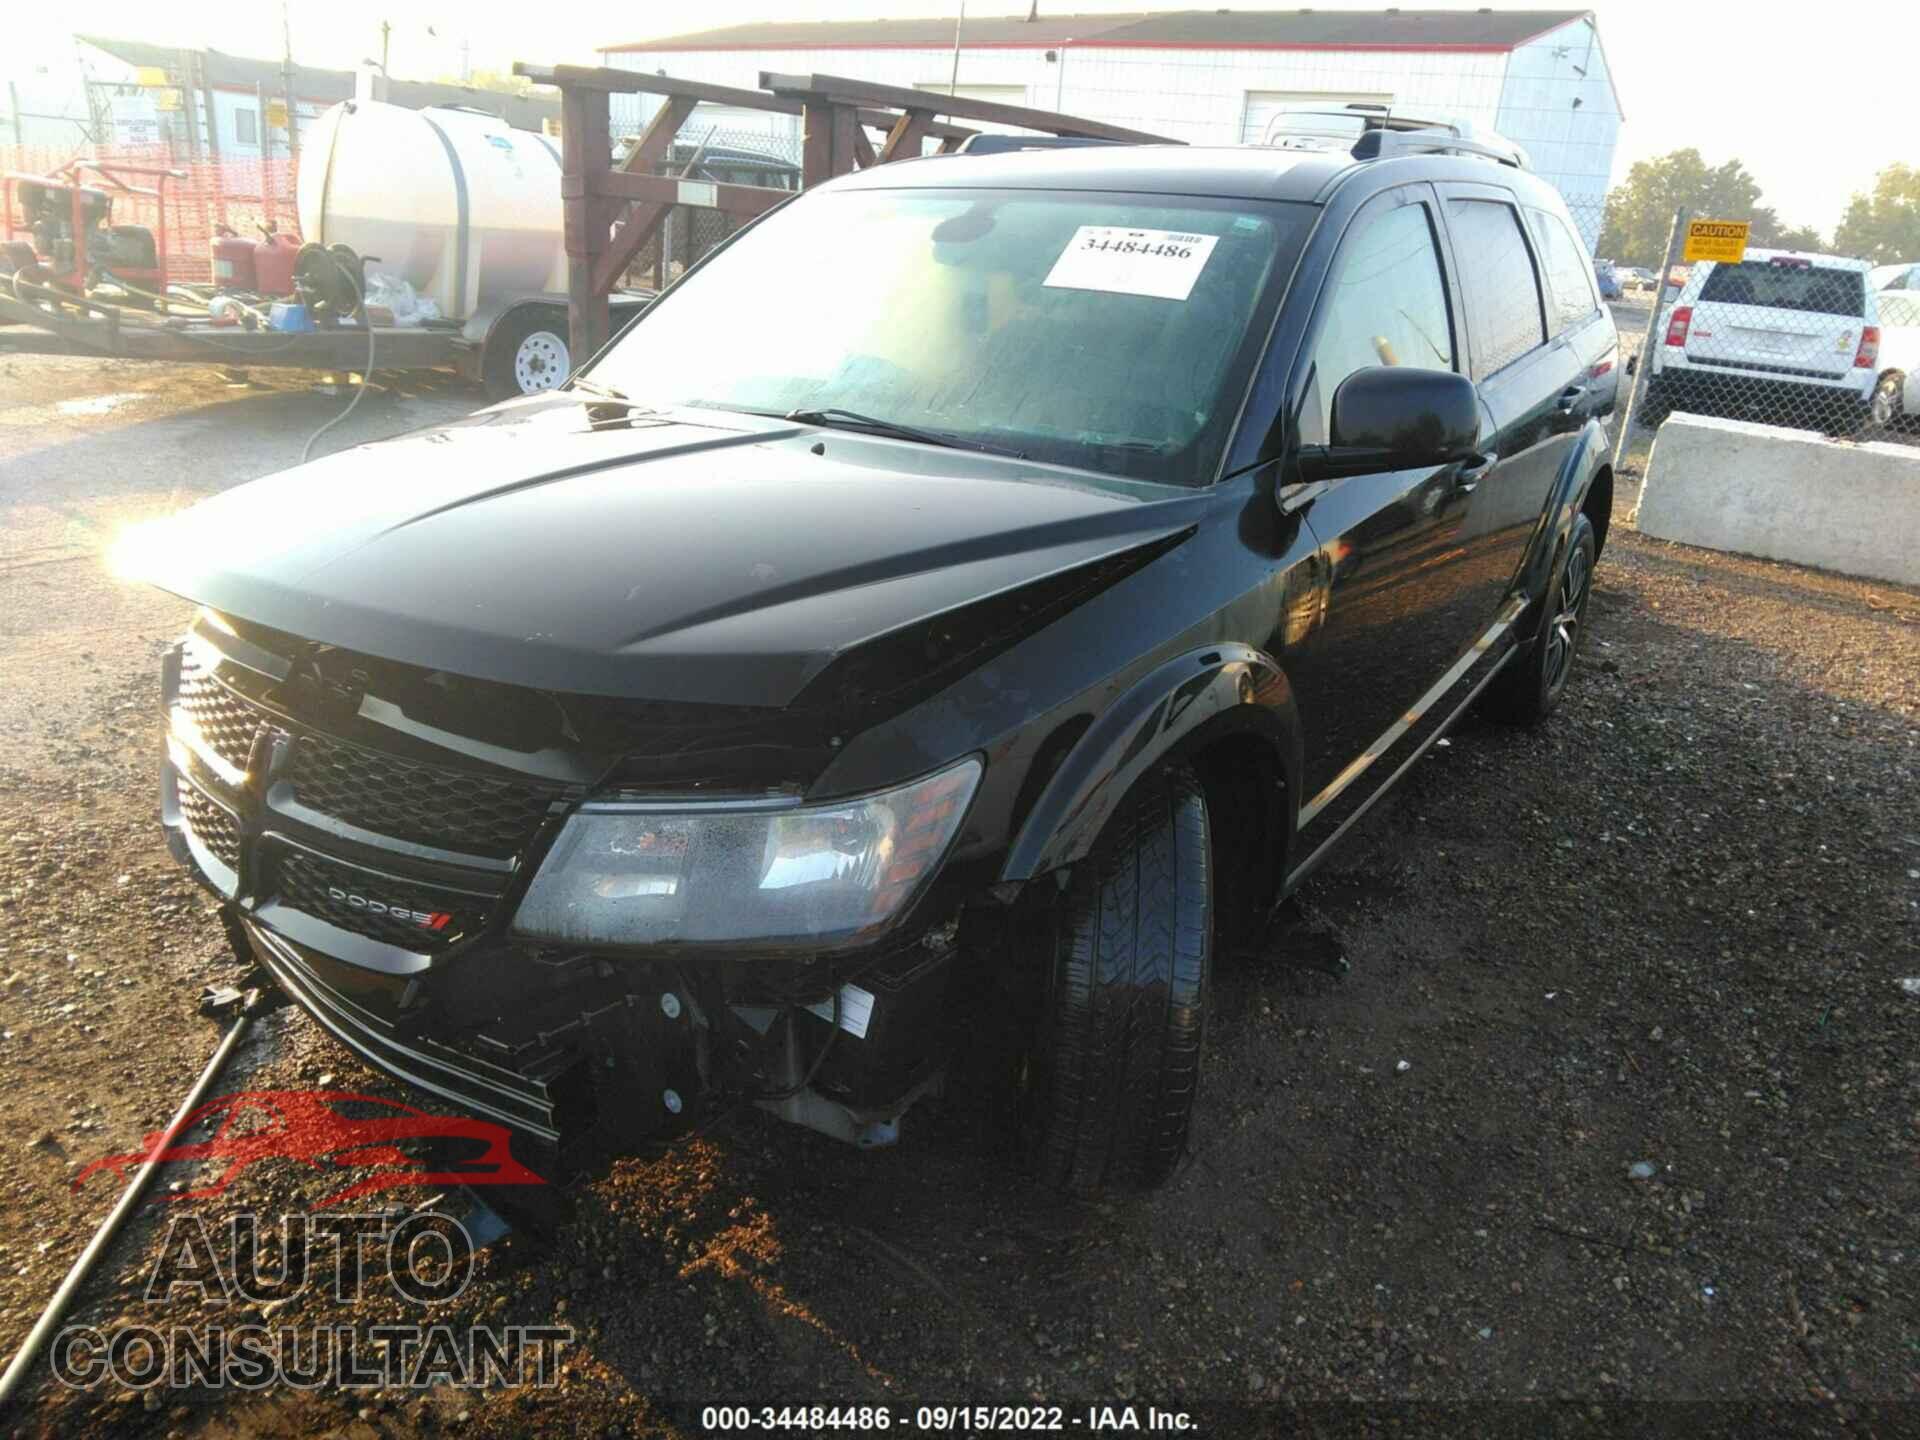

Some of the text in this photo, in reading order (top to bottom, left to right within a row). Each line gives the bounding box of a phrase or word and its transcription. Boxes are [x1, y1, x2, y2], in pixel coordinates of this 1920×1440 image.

[1692, 224, 1745, 237] CAUTION
[1080, 238, 1193, 259] 34484486
[328, 887, 433, 925] DODGE
